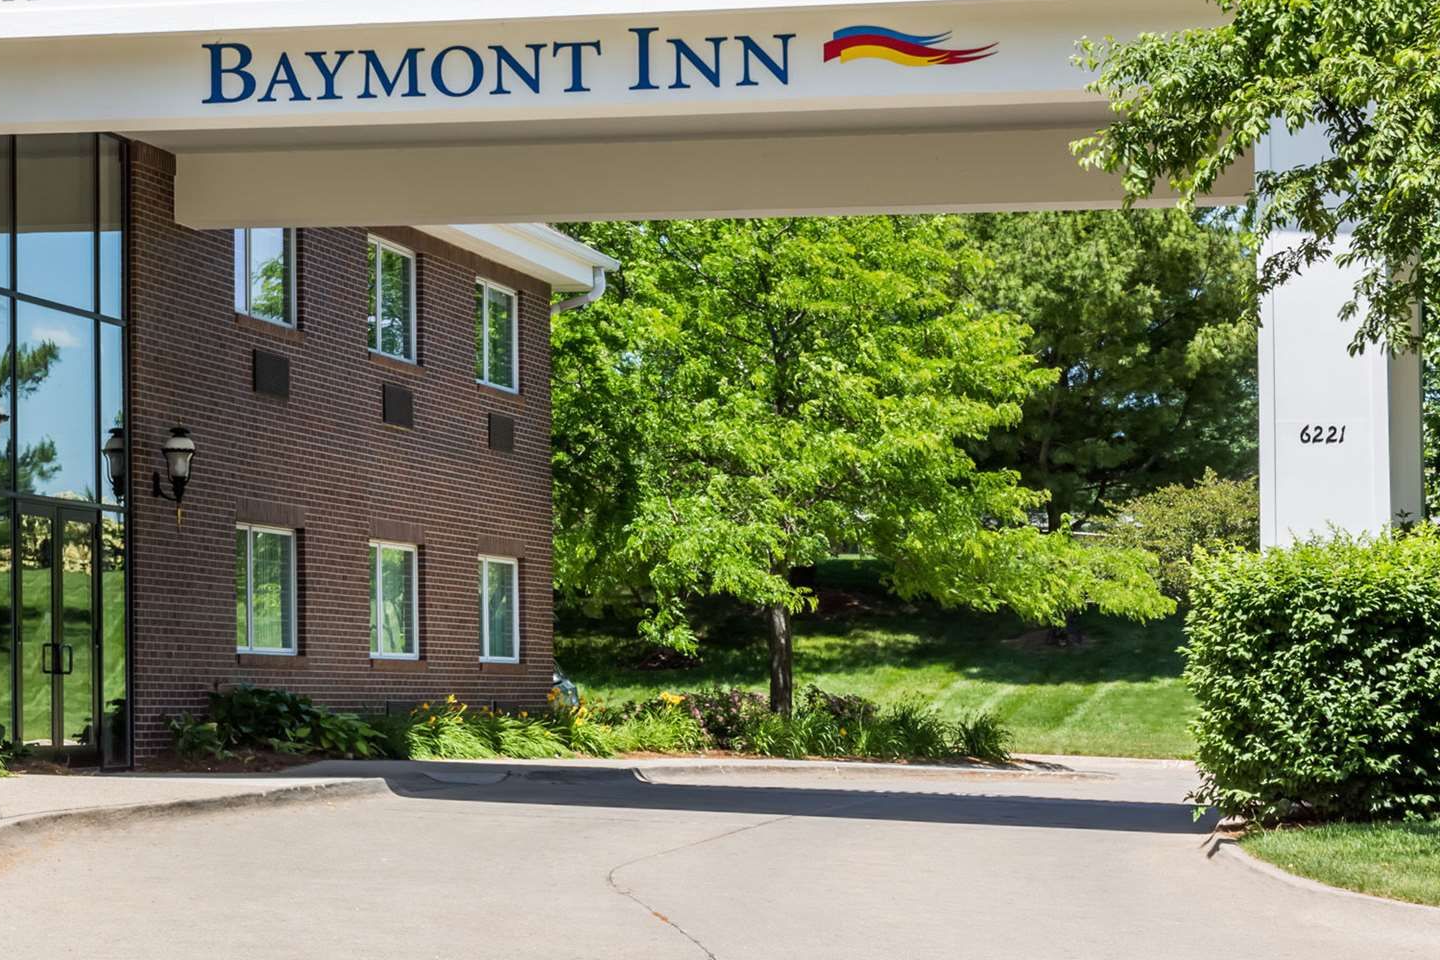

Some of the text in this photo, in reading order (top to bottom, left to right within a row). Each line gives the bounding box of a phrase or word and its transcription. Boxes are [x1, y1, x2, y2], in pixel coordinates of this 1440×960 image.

[201, 27, 797, 104] BAYMONT INN
[1299, 424, 1346, 444] 6221
